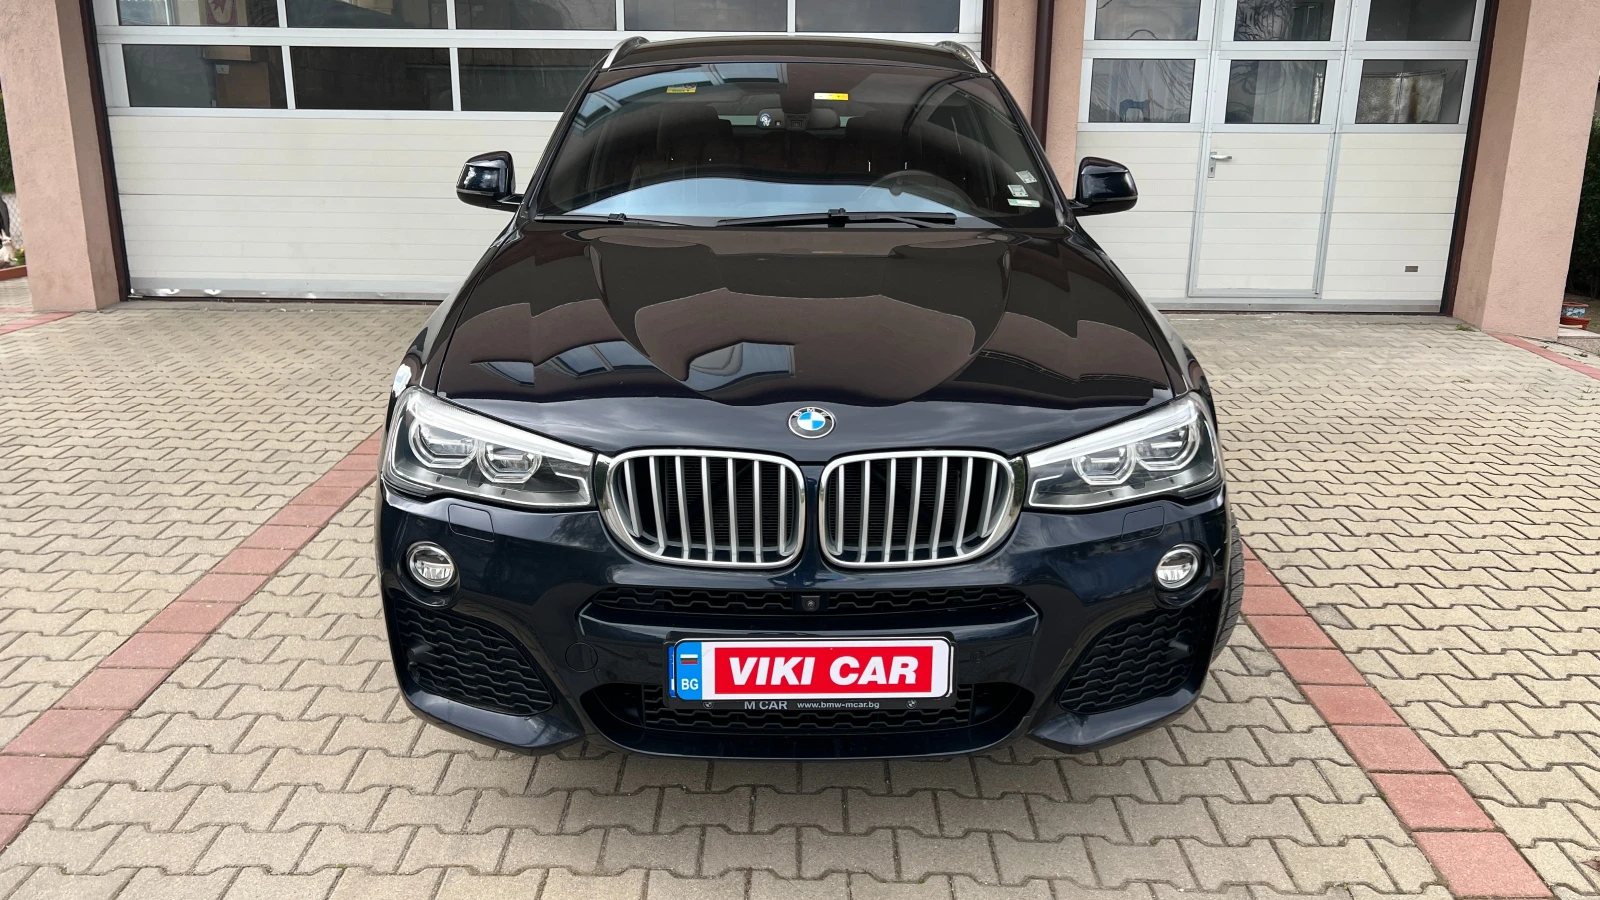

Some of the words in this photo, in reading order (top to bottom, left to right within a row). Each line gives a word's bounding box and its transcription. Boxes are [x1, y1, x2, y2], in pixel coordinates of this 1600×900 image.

[729, 656, 816, 686] VIKI
[829, 655, 919, 686] CAR
[681, 678, 699, 691] BG
[744, 700, 756, 710] M
[759, 700, 788, 710] CAR
[797, 701, 880, 710] www.bmw-mcar.bg
